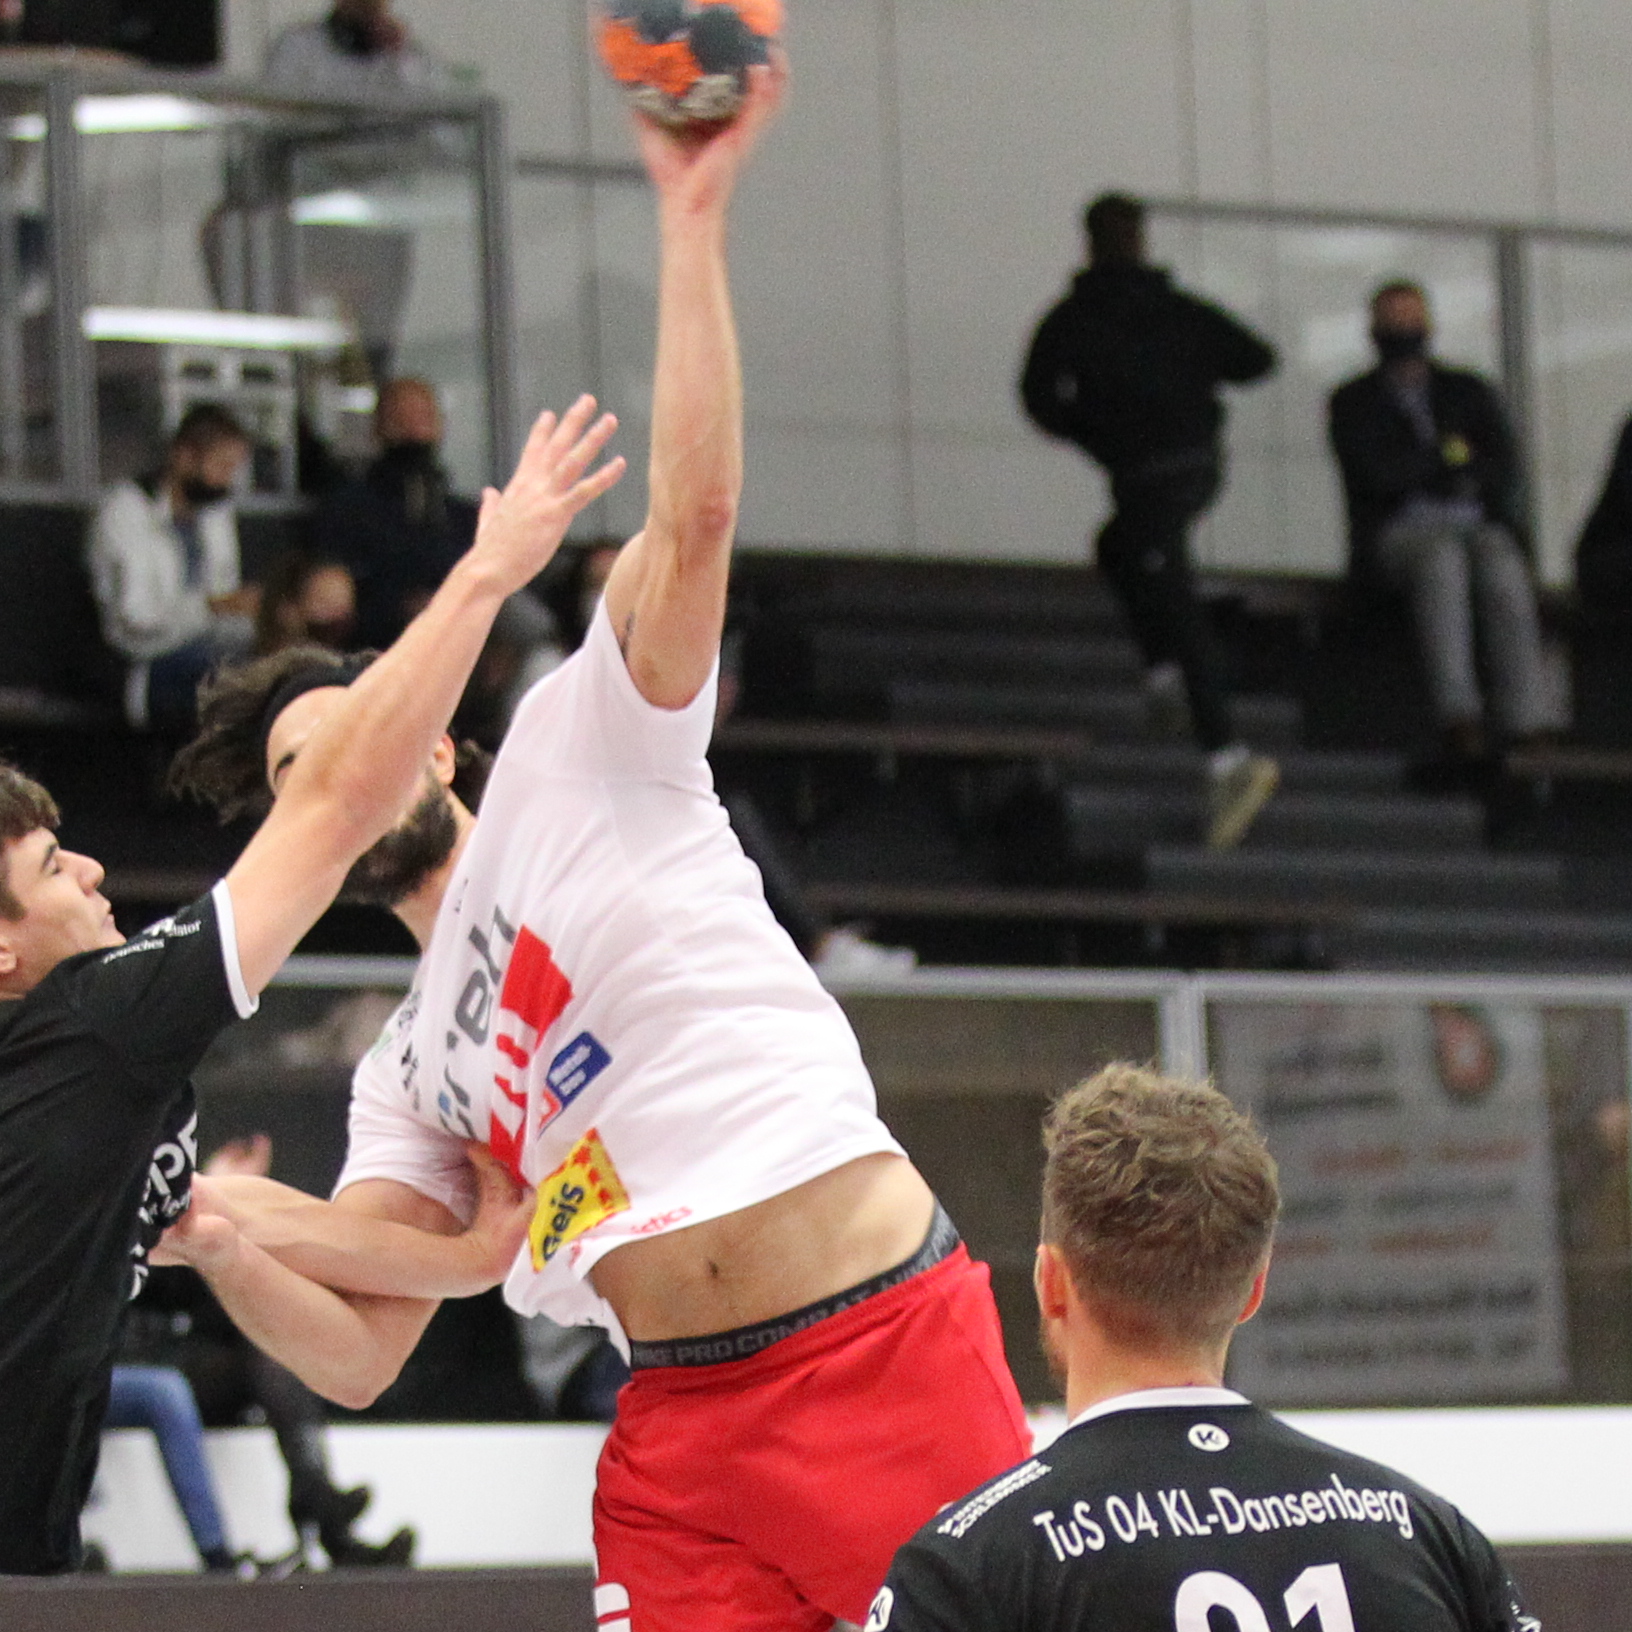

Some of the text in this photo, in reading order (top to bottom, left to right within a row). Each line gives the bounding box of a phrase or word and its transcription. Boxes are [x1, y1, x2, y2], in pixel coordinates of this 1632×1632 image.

[542, 1181, 585, 1262] Geis
[1031, 1473, 1415, 1562] TuS 04 KL-Dansenberg
